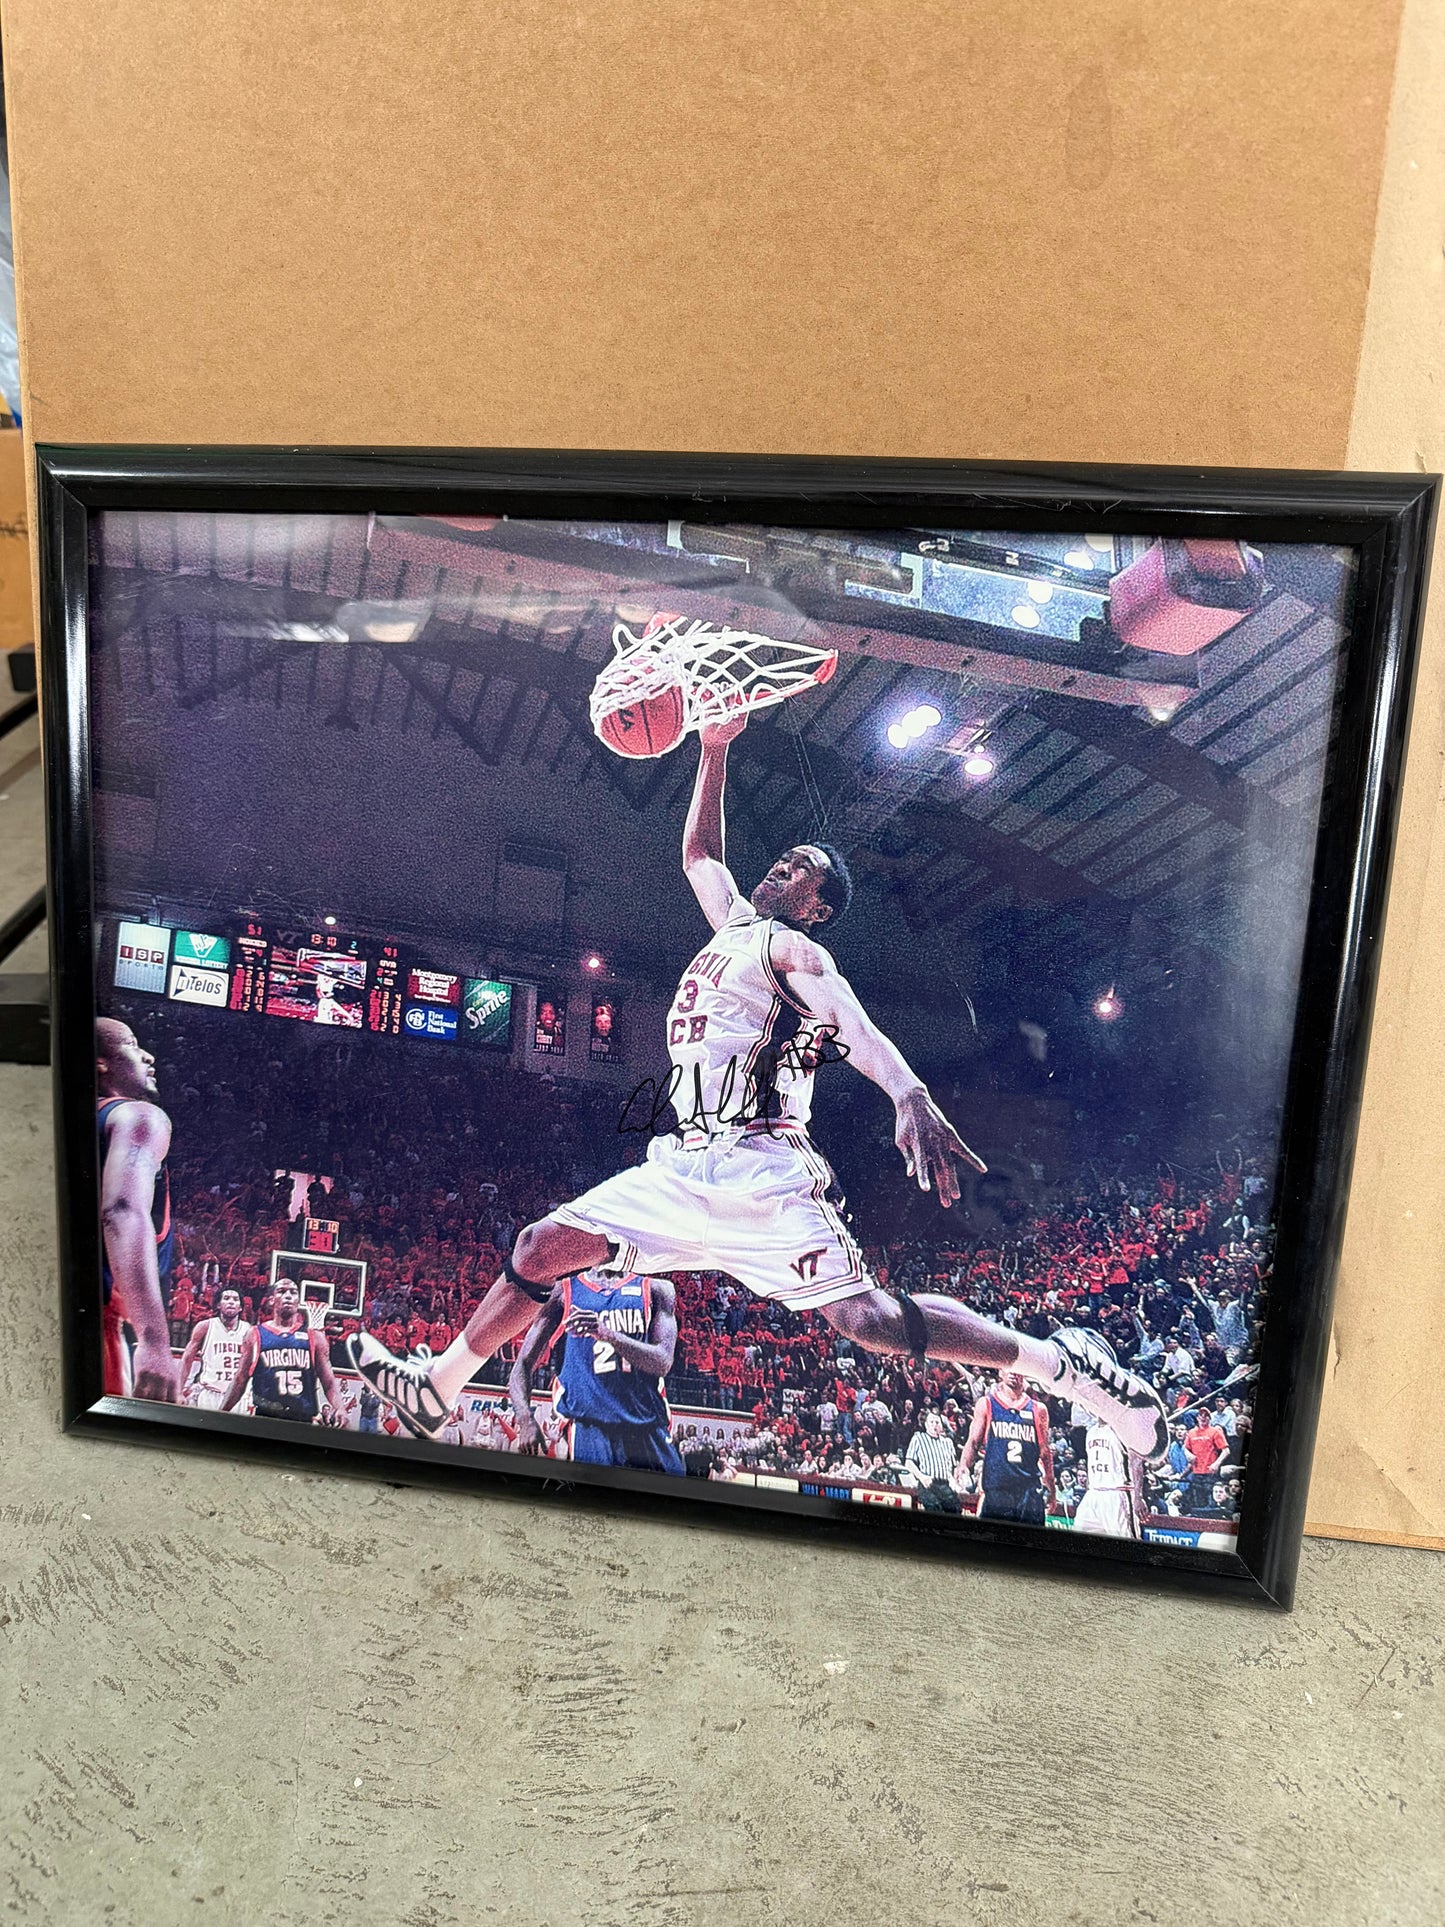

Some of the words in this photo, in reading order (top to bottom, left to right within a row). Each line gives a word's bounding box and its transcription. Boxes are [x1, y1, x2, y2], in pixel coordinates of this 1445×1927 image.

[121, 946, 164, 963] ISP
[178, 975, 222, 995] nTelos
[428, 1010, 444, 1020] First
[465, 990, 511, 1030] Sprite
[427, 1025, 445, 1034] Bank
[428, 1019, 457, 1028] National
[789, 1246, 828, 1282] VT
[261, 1348, 311, 1370] VIRGINIA
[275, 1370, 304, 1396] 15
[991, 1421, 1036, 1443] VIRGINIA
[1007, 1440, 1022, 1463] 2
